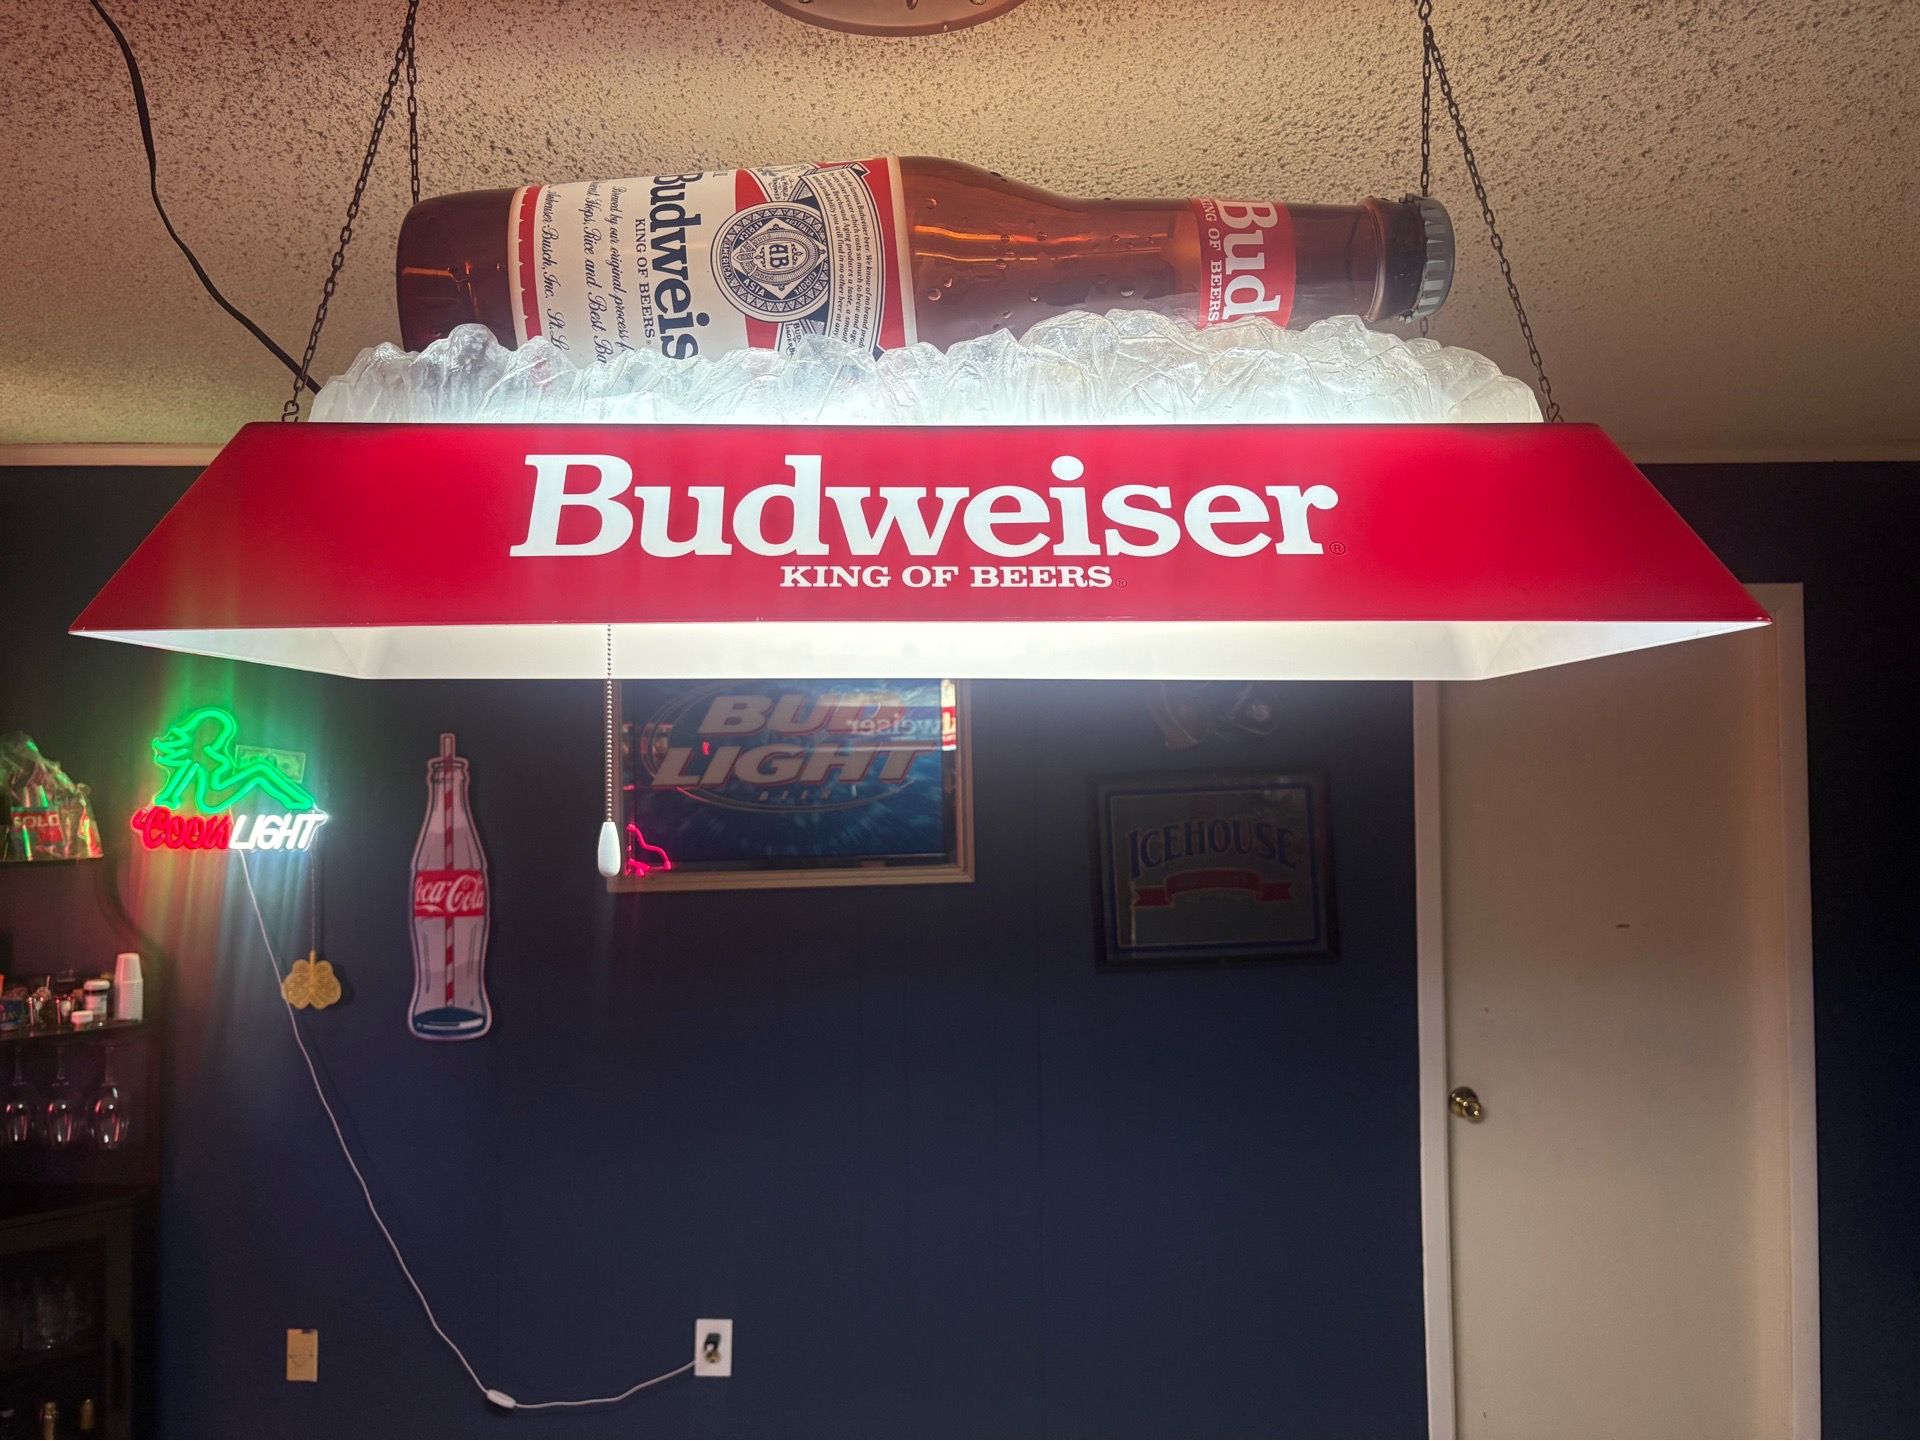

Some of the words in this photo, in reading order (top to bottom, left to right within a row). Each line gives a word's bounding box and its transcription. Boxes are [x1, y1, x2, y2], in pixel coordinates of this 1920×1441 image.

[610, 186, 627, 212] Brewed
[833, 191, 848, 221] Beechwood
[844, 195, 854, 213] brewer
[578, 197, 603, 224] Hops,
[604, 214, 622, 224] by
[830, 214, 839, 224] you
[858, 206, 868, 236] Budweiser
[739, 221, 762, 241] AFRICA
[785, 219, 814, 237] AUSTRALIA
[835, 226, 843, 238] will
[843, 223, 852, 244] Aging
[851, 214, 860, 233] which
[583, 226, 602, 255] Rice
[610, 227, 619, 245] our
[635, 218, 646, 253] KING
[837, 239, 845, 253] find
[1208, 228, 1221, 250] OF
[722, 244, 731, 276] AMERICA
[769, 244, 789, 268] AB
[845, 244, 854, 277] produces
[865, 255, 872, 265] We
[1215, 200, 1281, 320] Bud
[585, 259, 602, 289] and
[606, 247, 627, 293] original
[637, 257, 648, 278] OF
[839, 263, 845, 273] no
[543, 272, 561, 299] Inc.
[743, 279, 765, 297] ASIA
[793, 271, 817, 295] EUROPE
[865, 288, 872, 296] of
[1208, 260, 1222, 321] BEERS
[837, 296, 845, 312] beer
[846, 287, 854, 306] taste,
[855, 293, 863, 312] brew
[865, 296, 870, 305] no
[547, 308, 566, 330] St.
[588, 292, 608, 331] Best
[609, 294, 630, 340] process
[639, 283, 655, 338] BEERS
[836, 313, 843, 322] at
[862, 306, 871, 329] brand
[832, 323, 840, 336] any
[510, 454, 1339, 557] Budweiser
[780, 566, 892, 588] KING
[901, 566, 959, 588] OF
[970, 566, 1113, 588] BEERS
[697, 693, 908, 737] BUD
[650, 741, 945, 788] LIGHT
[229, 813, 329, 851] LIGHT
[1128, 818, 1297, 882] ICEHOUSE
